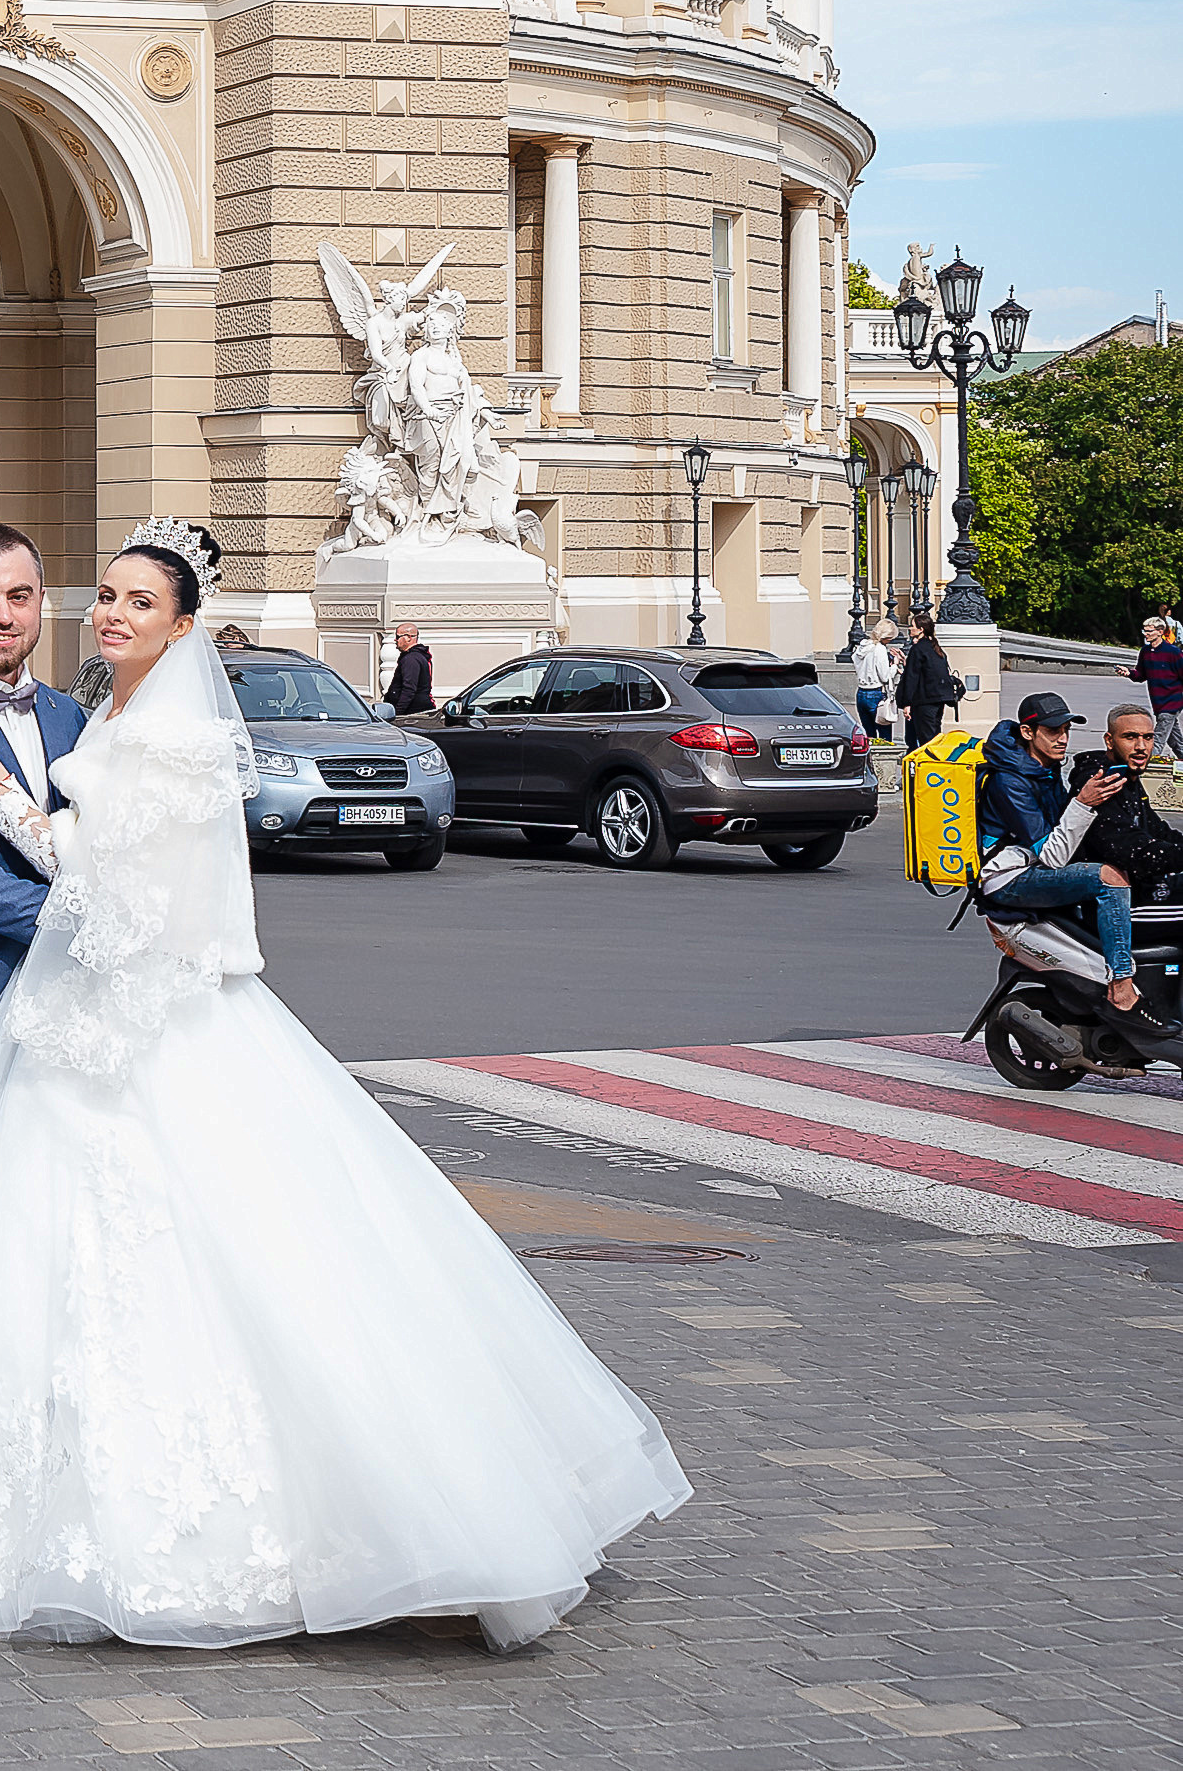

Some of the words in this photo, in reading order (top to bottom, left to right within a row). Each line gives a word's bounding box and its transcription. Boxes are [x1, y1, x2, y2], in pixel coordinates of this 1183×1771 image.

[799, 750, 818, 761] 3311
[346, 808, 361, 820] BH
[363, 808, 387, 820] 4059
[937, 787, 965, 875] Glovo
